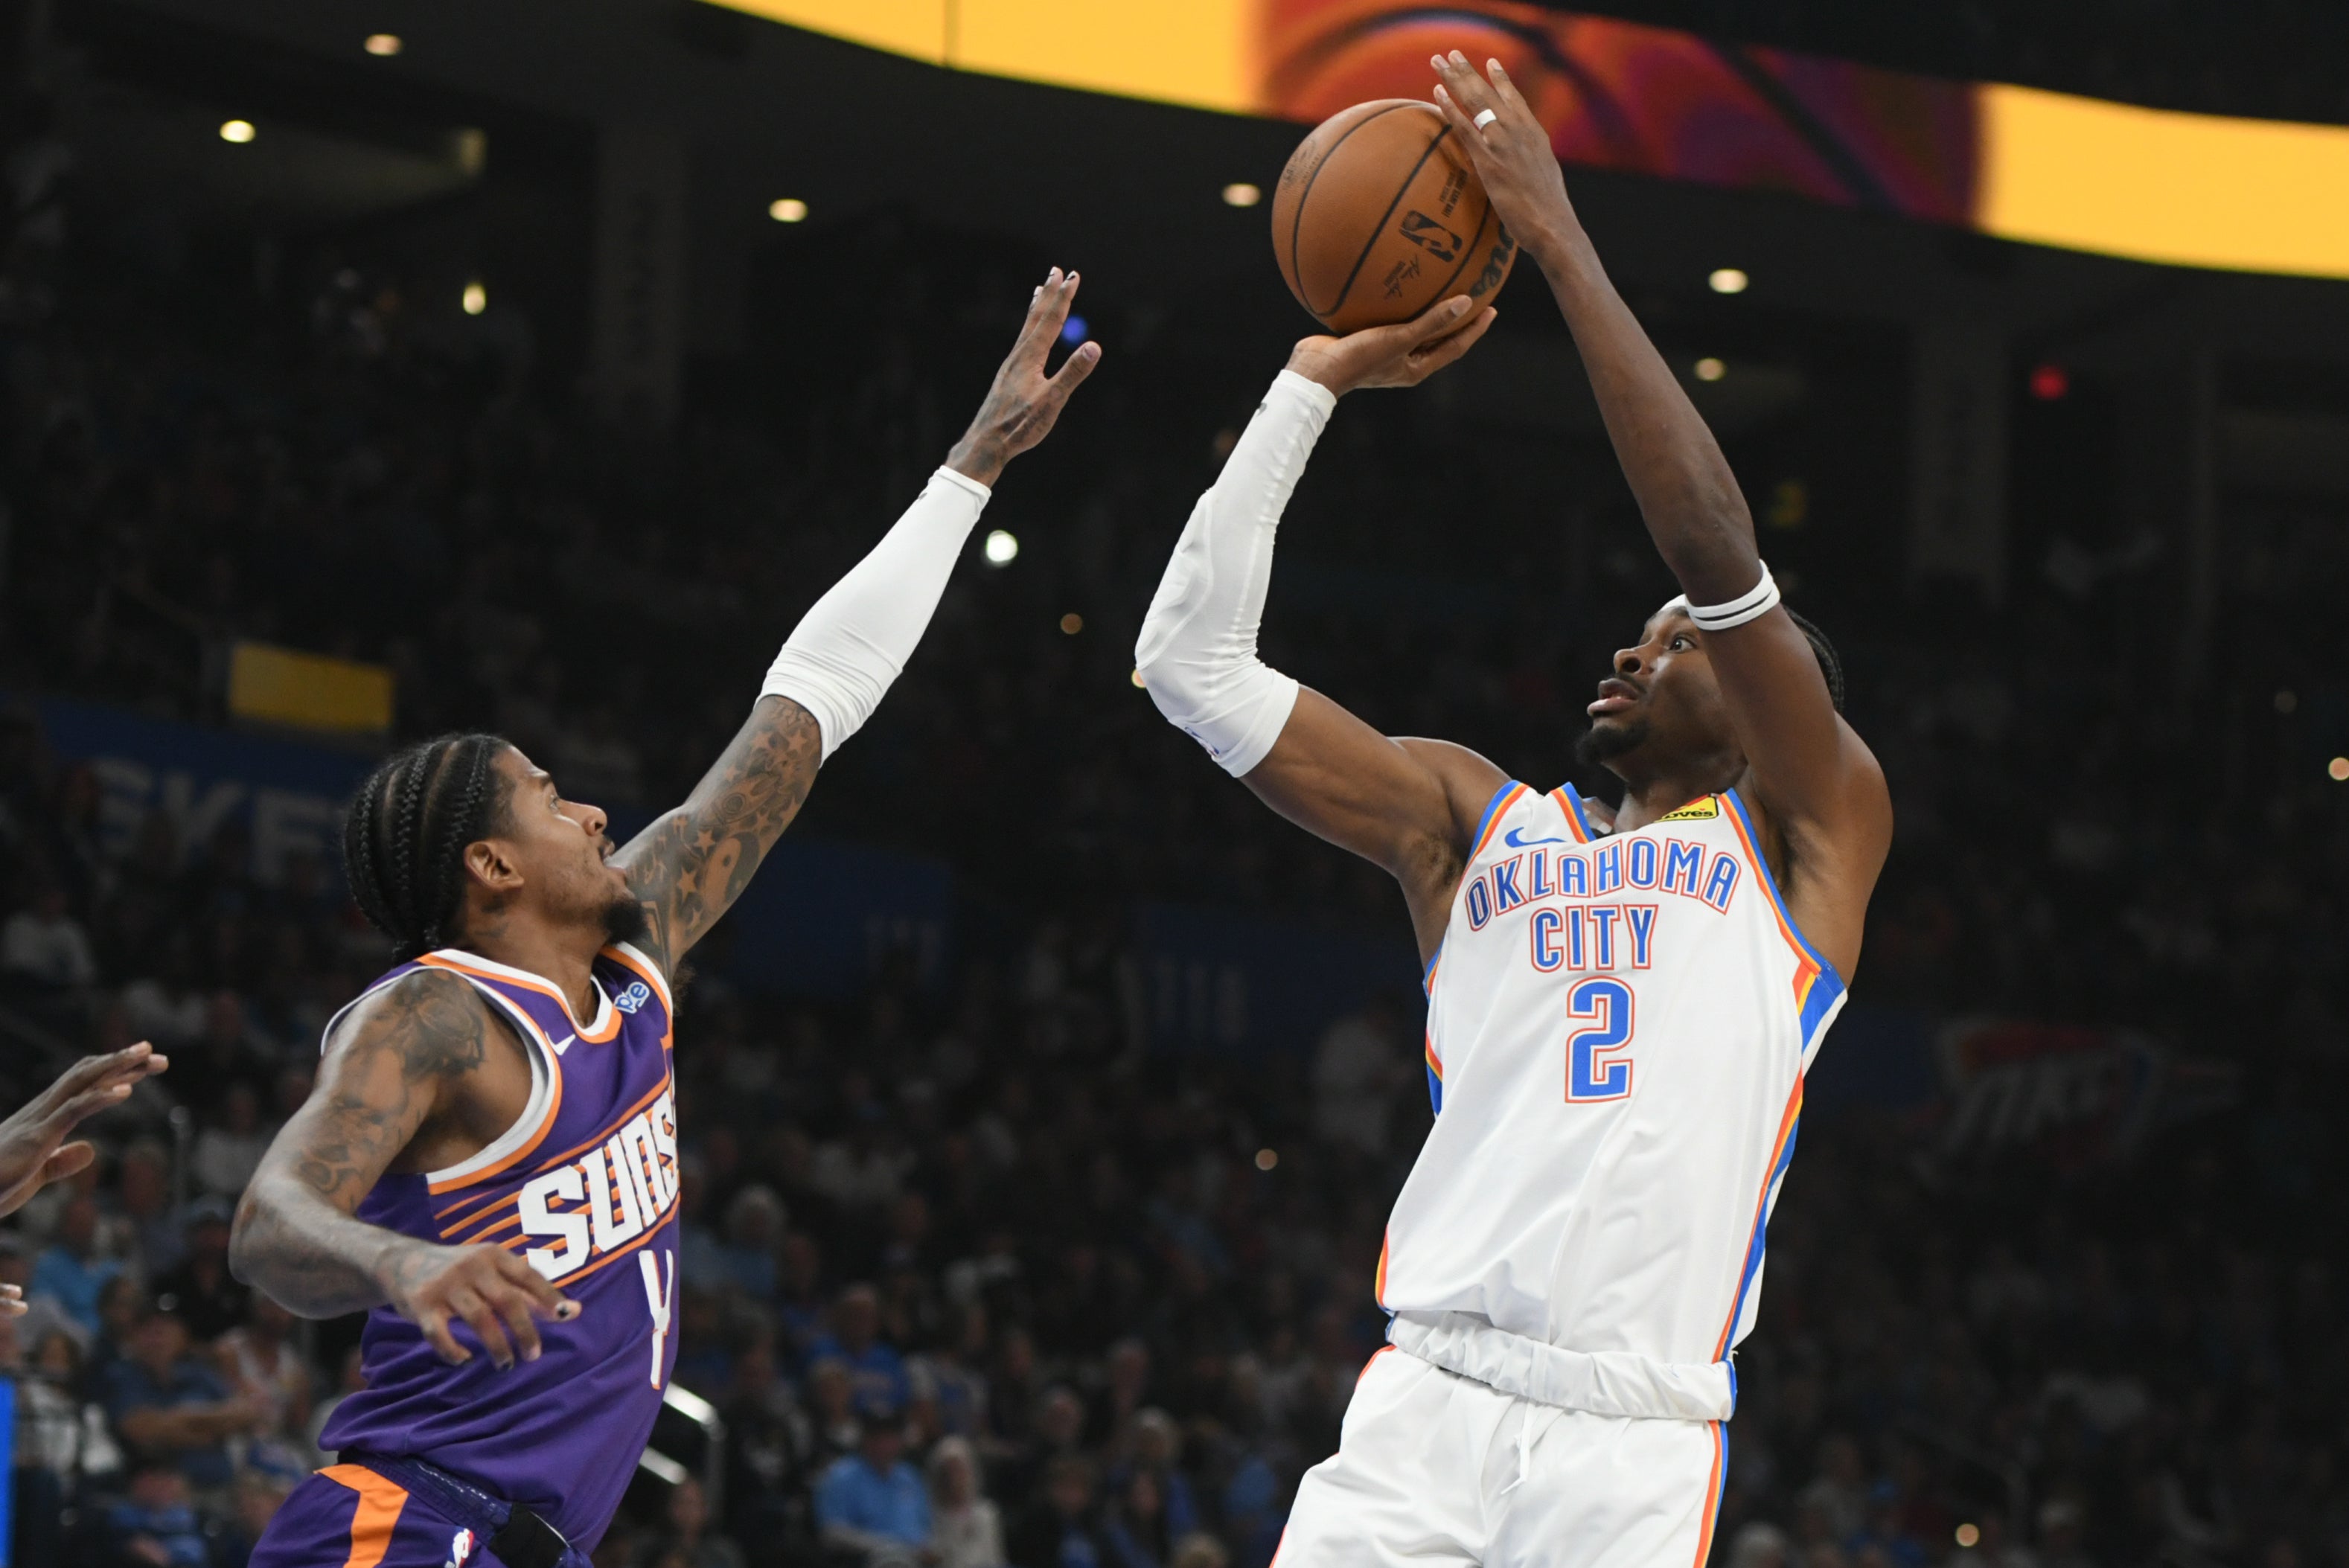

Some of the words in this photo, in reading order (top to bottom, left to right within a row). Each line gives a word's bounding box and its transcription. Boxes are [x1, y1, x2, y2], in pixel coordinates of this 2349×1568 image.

[1664, 810, 1714, 819] oves
[1466, 836, 1741, 932] OKLAHOMA
[1530, 903, 1659, 973] CITY
[1565, 975, 1634, 1103] 2
[517, 1089, 679, 1281] SUNS
